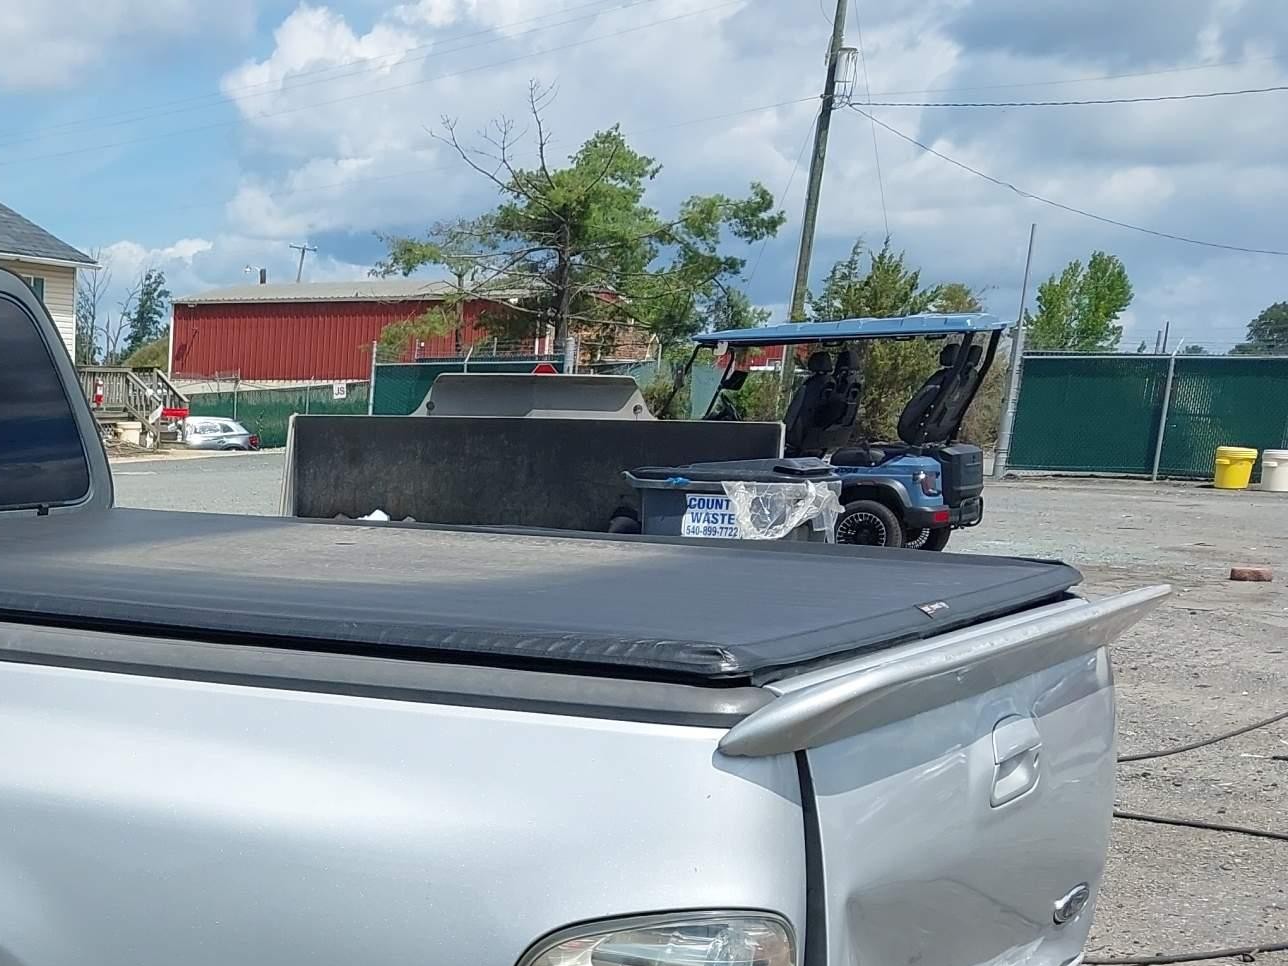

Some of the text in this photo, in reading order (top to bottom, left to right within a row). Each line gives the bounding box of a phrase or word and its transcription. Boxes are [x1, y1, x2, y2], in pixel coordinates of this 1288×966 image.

[688, 497, 734, 511] COUNT
[691, 511, 736, 525] WASTE
[686, 525, 739, 537] 540-899-7722
